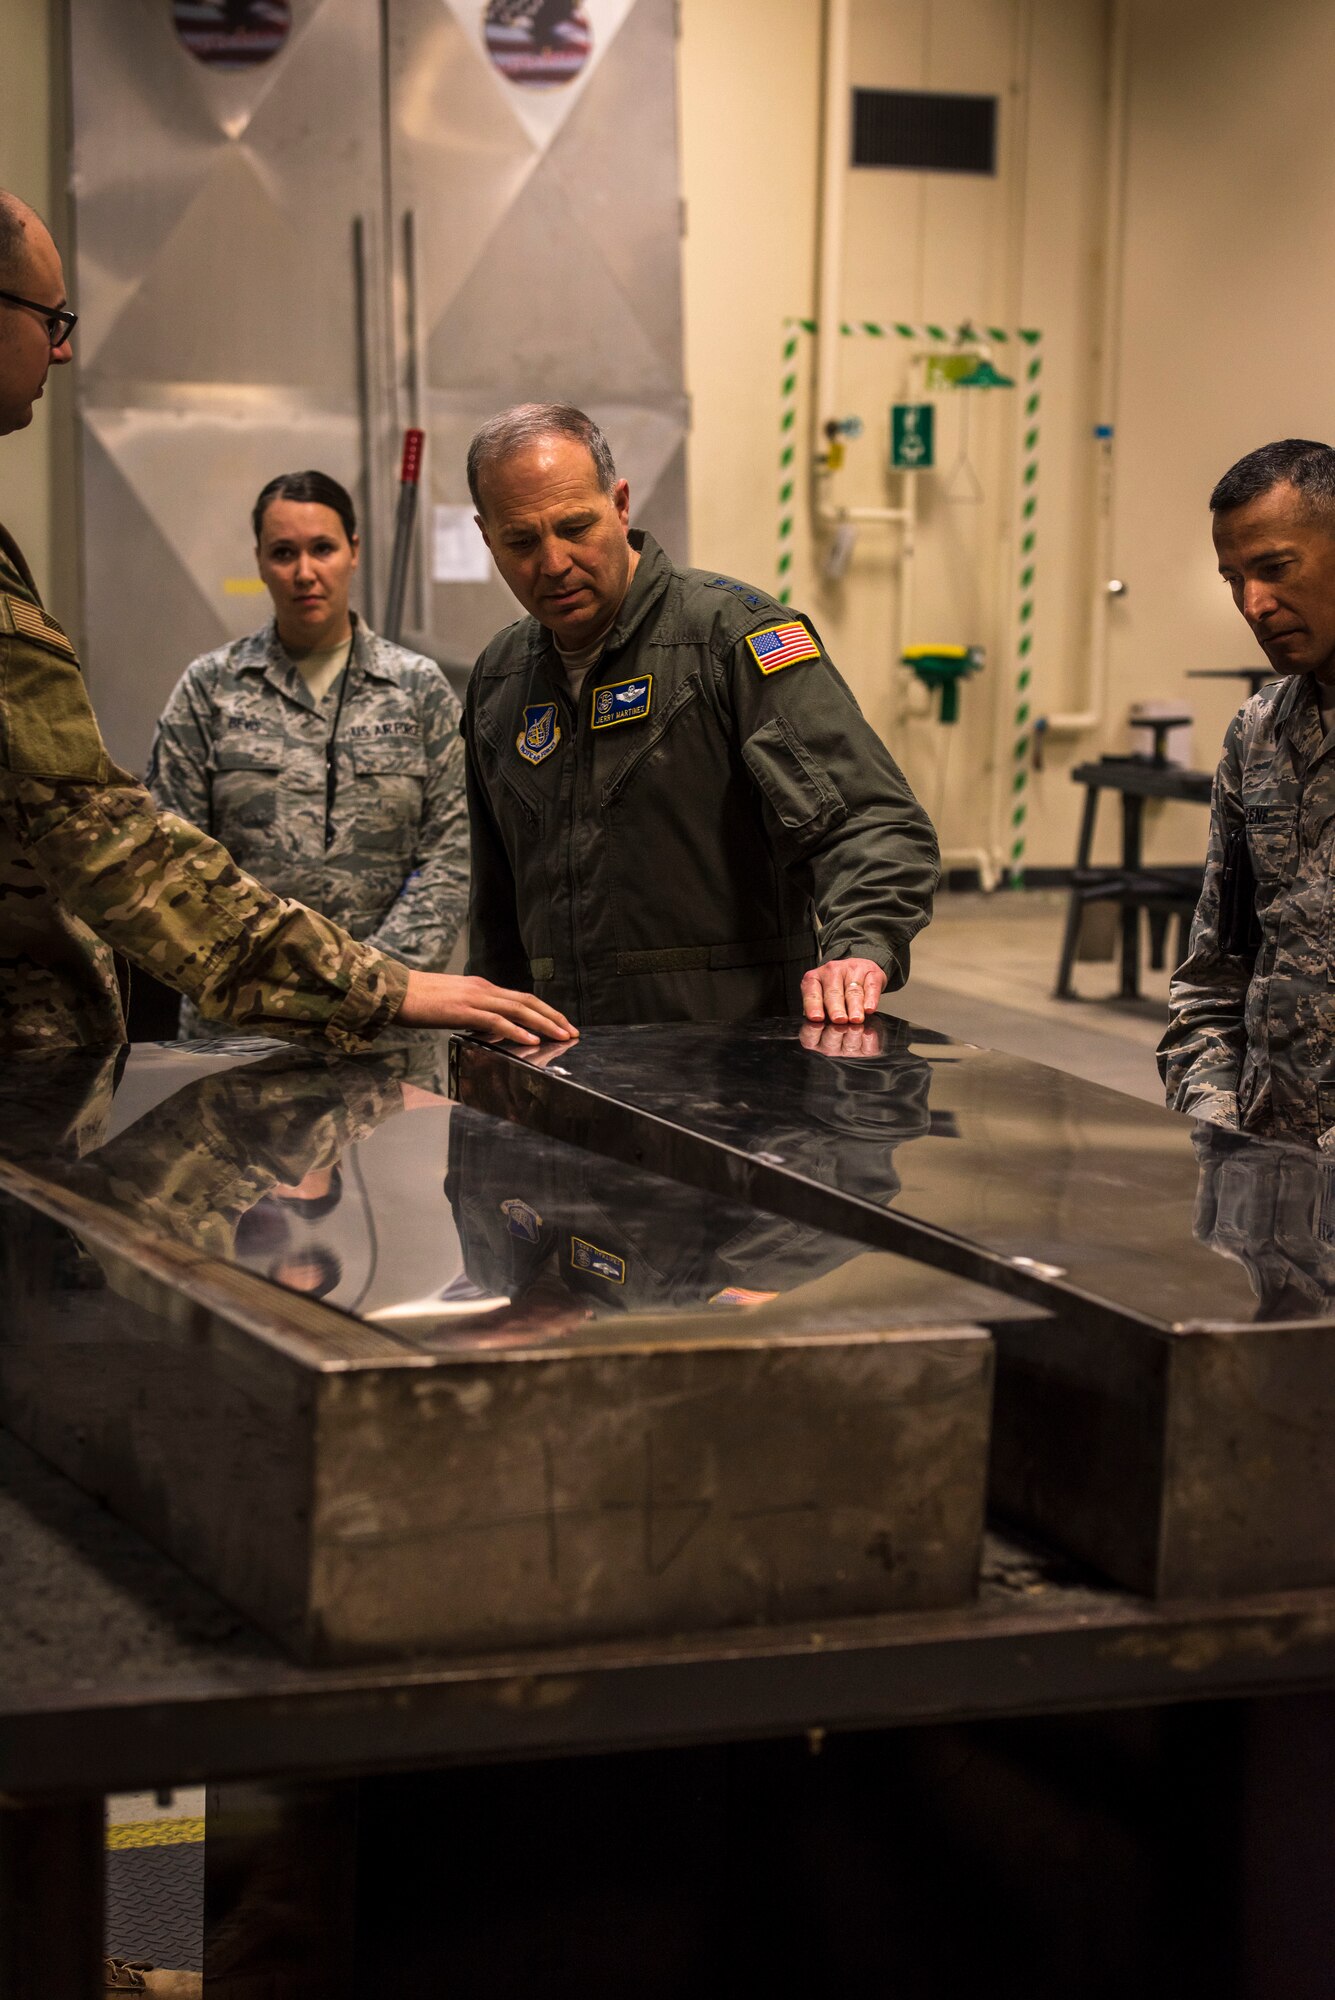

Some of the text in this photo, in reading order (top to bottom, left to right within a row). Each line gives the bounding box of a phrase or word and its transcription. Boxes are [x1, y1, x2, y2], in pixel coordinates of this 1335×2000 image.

[596, 705, 645, 724] JERRY MARTINEZ
[374, 724, 392, 735] AIR
